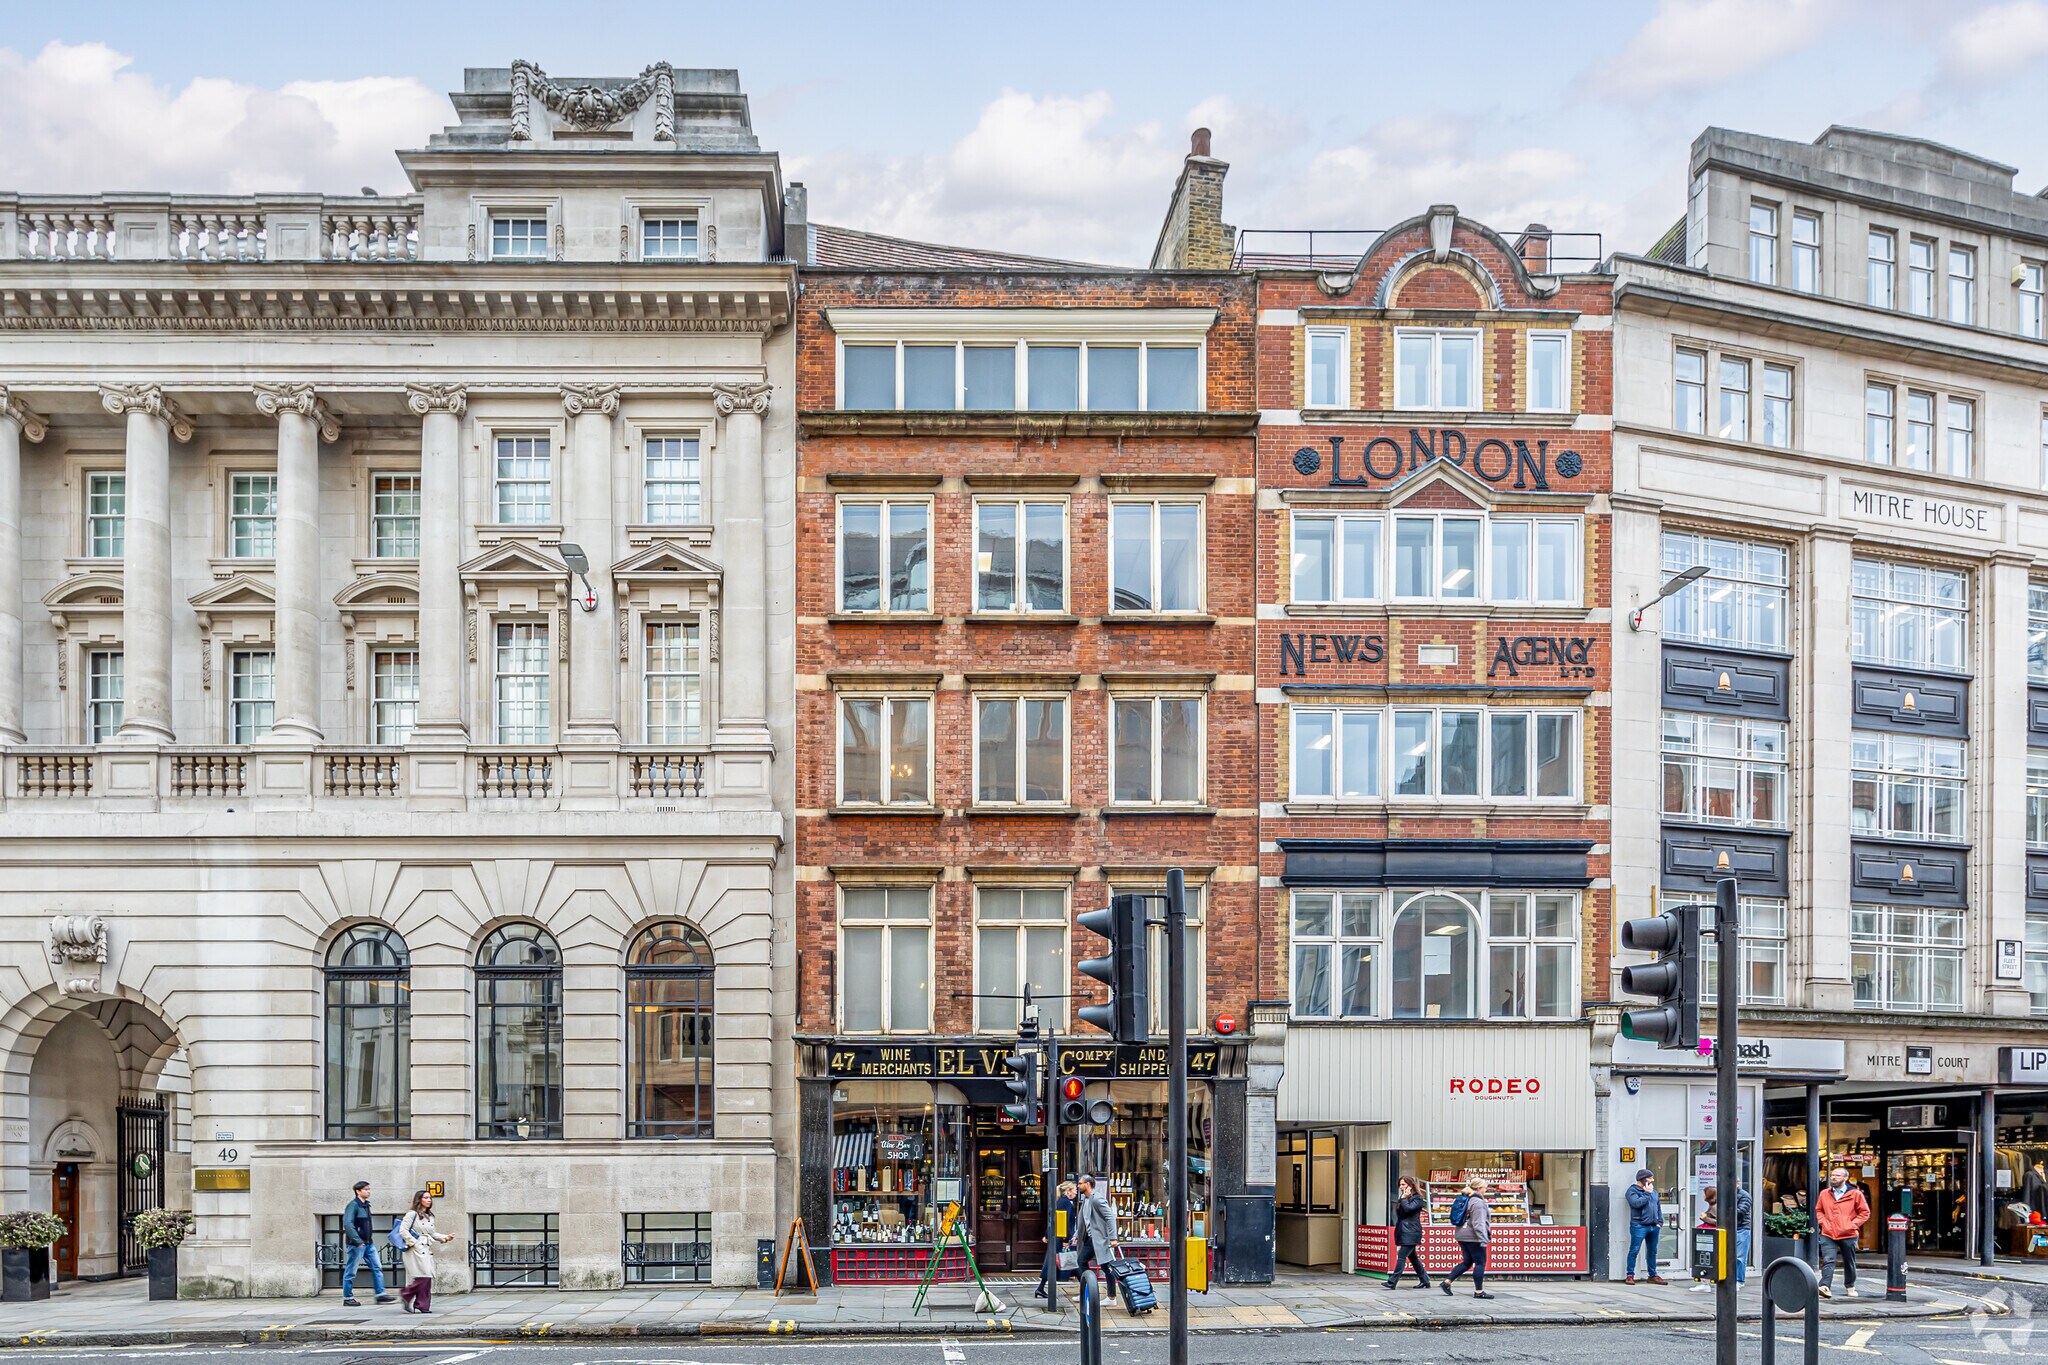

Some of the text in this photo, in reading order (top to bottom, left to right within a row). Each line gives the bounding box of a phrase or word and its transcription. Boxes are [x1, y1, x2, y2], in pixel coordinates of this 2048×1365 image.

[1328, 428, 1550, 490] LONDON
[1853, 490, 1988, 532] MITRE HOUSE
[1279, 633, 1597, 677] NEWS AGENCY
[880, 1048, 911, 1061] WINE
[1138, 1048, 1165, 1061] AND
[831, 1052, 856, 1071] 47
[938, 1049, 974, 1075] EL
[1191, 1052, 1216, 1071] 47
[1867, 1055, 1970, 1068] MITRE COURT
[861, 1063, 932, 1075] MERCHANTS
[1119, 1063, 1170, 1075] SHIPPE
[1449, 1078, 1541, 1094] RODEO
[217, 1147, 238, 1163] 49
[887, 1151, 909, 1160] SHOP
[1358, 1235, 1388, 1243] DOUGHNUTS
[1358, 1243, 1388, 1252] DOUGHNUTS
[1358, 1251, 1388, 1259] DOUGHNUTS
[1358, 1259, 1388, 1268] DOUGHNUTS
